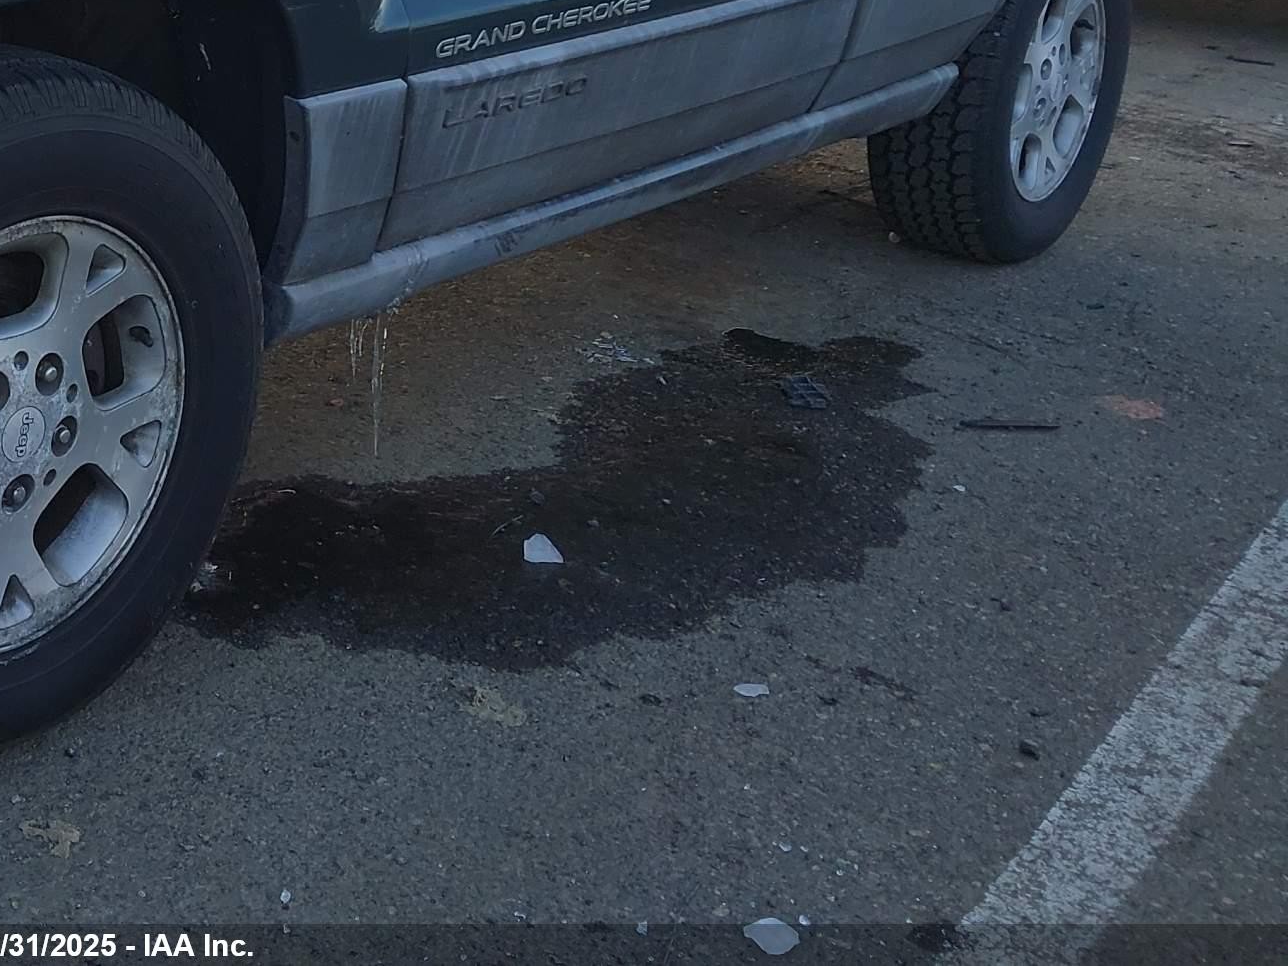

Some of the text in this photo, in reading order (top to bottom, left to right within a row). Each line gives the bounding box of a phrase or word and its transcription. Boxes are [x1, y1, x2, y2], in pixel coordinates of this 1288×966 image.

[435, 20, 526, 59] GRAND
[442, 76, 588, 129] LAREDO
[15, 412, 35, 458] Jeep
